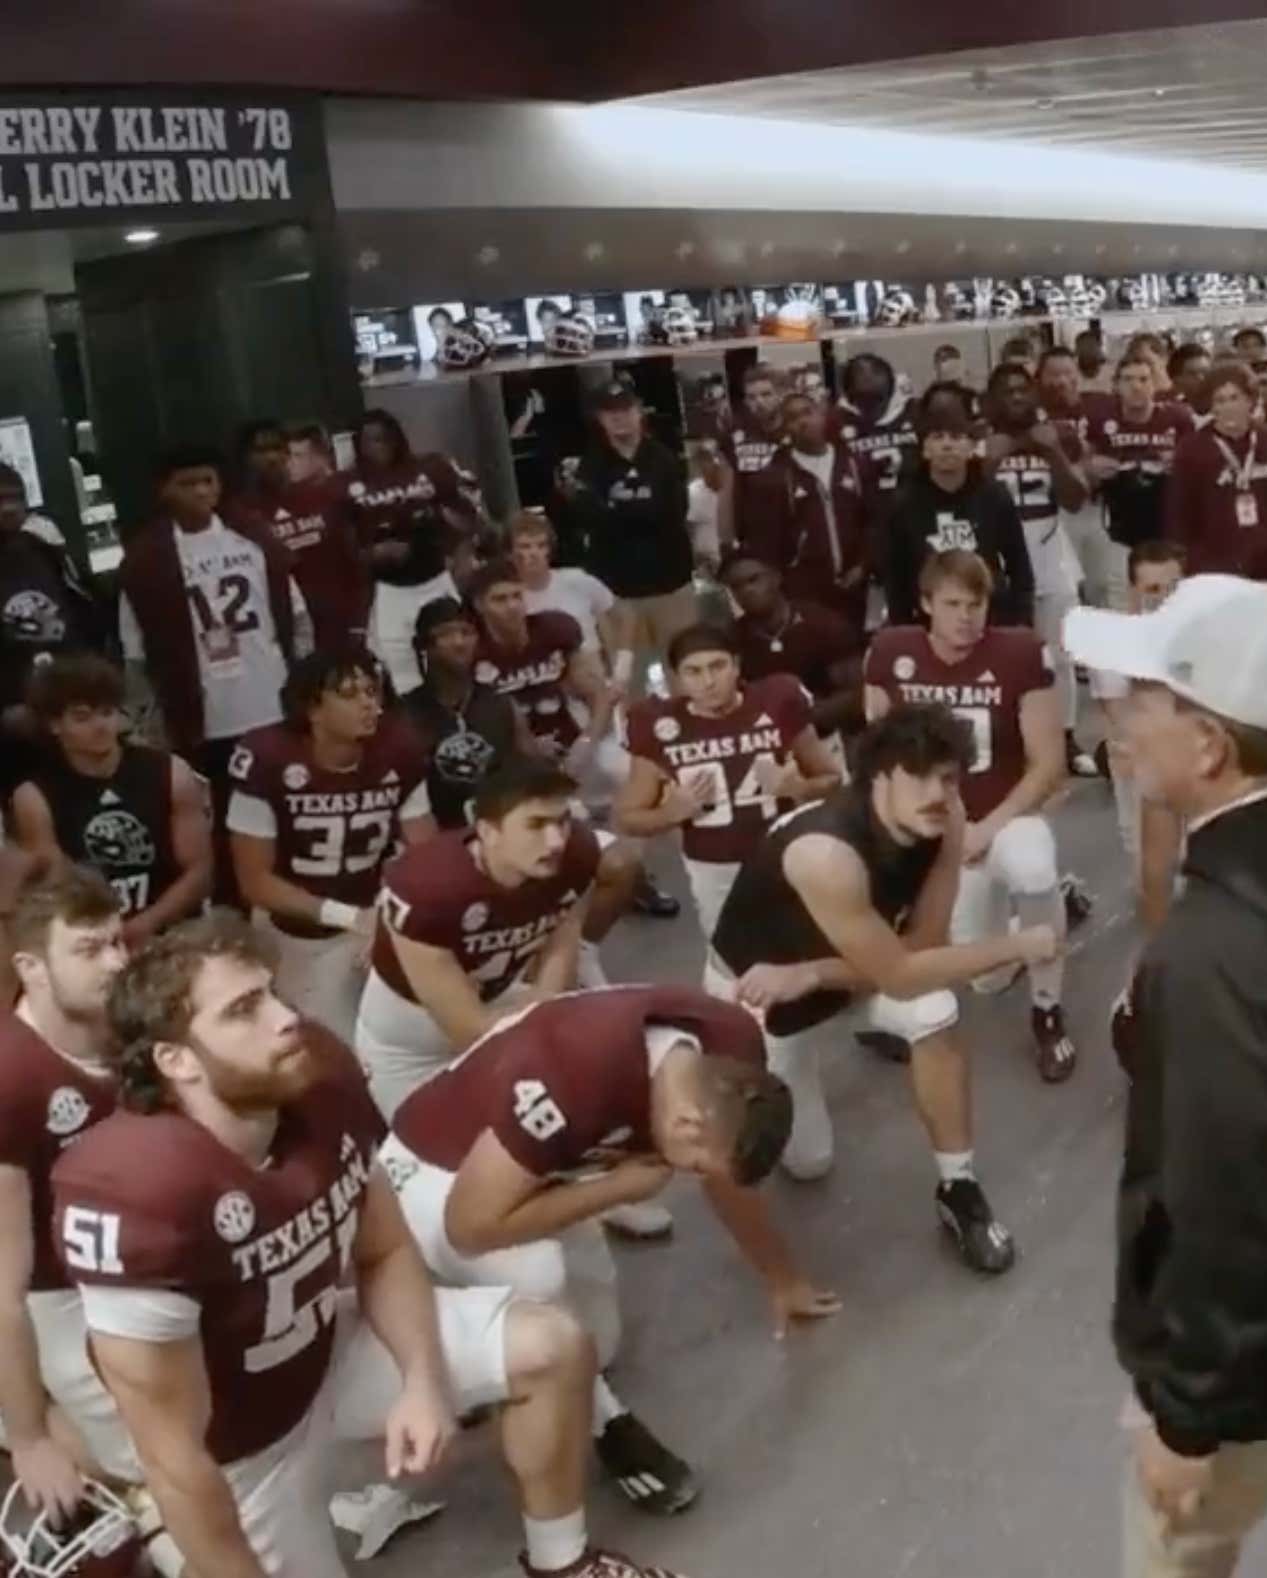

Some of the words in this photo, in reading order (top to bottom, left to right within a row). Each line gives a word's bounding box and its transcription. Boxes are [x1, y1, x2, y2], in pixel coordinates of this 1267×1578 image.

[0, 108, 101, 154] ERRY
[111, 107, 228, 152] KLEIN
[25, 158, 182, 210] LOCKER
[187, 156, 292, 202] ROOM
[899, 683, 959, 705] TEXAS
[959, 686, 1002, 706] A&M
[663, 735, 737, 767] TEXAS
[738, 727, 783, 754] A&M
[284, 791, 358, 814] TEXAS
[360, 785, 401, 810] A&M
[290, 811, 393, 877] 33
[462, 921, 536, 954] TEXAS
[513, 1079, 568, 1142] 48
[62, 1205, 125, 1275] 51
[231, 1196, 331, 1282] TEXAS
